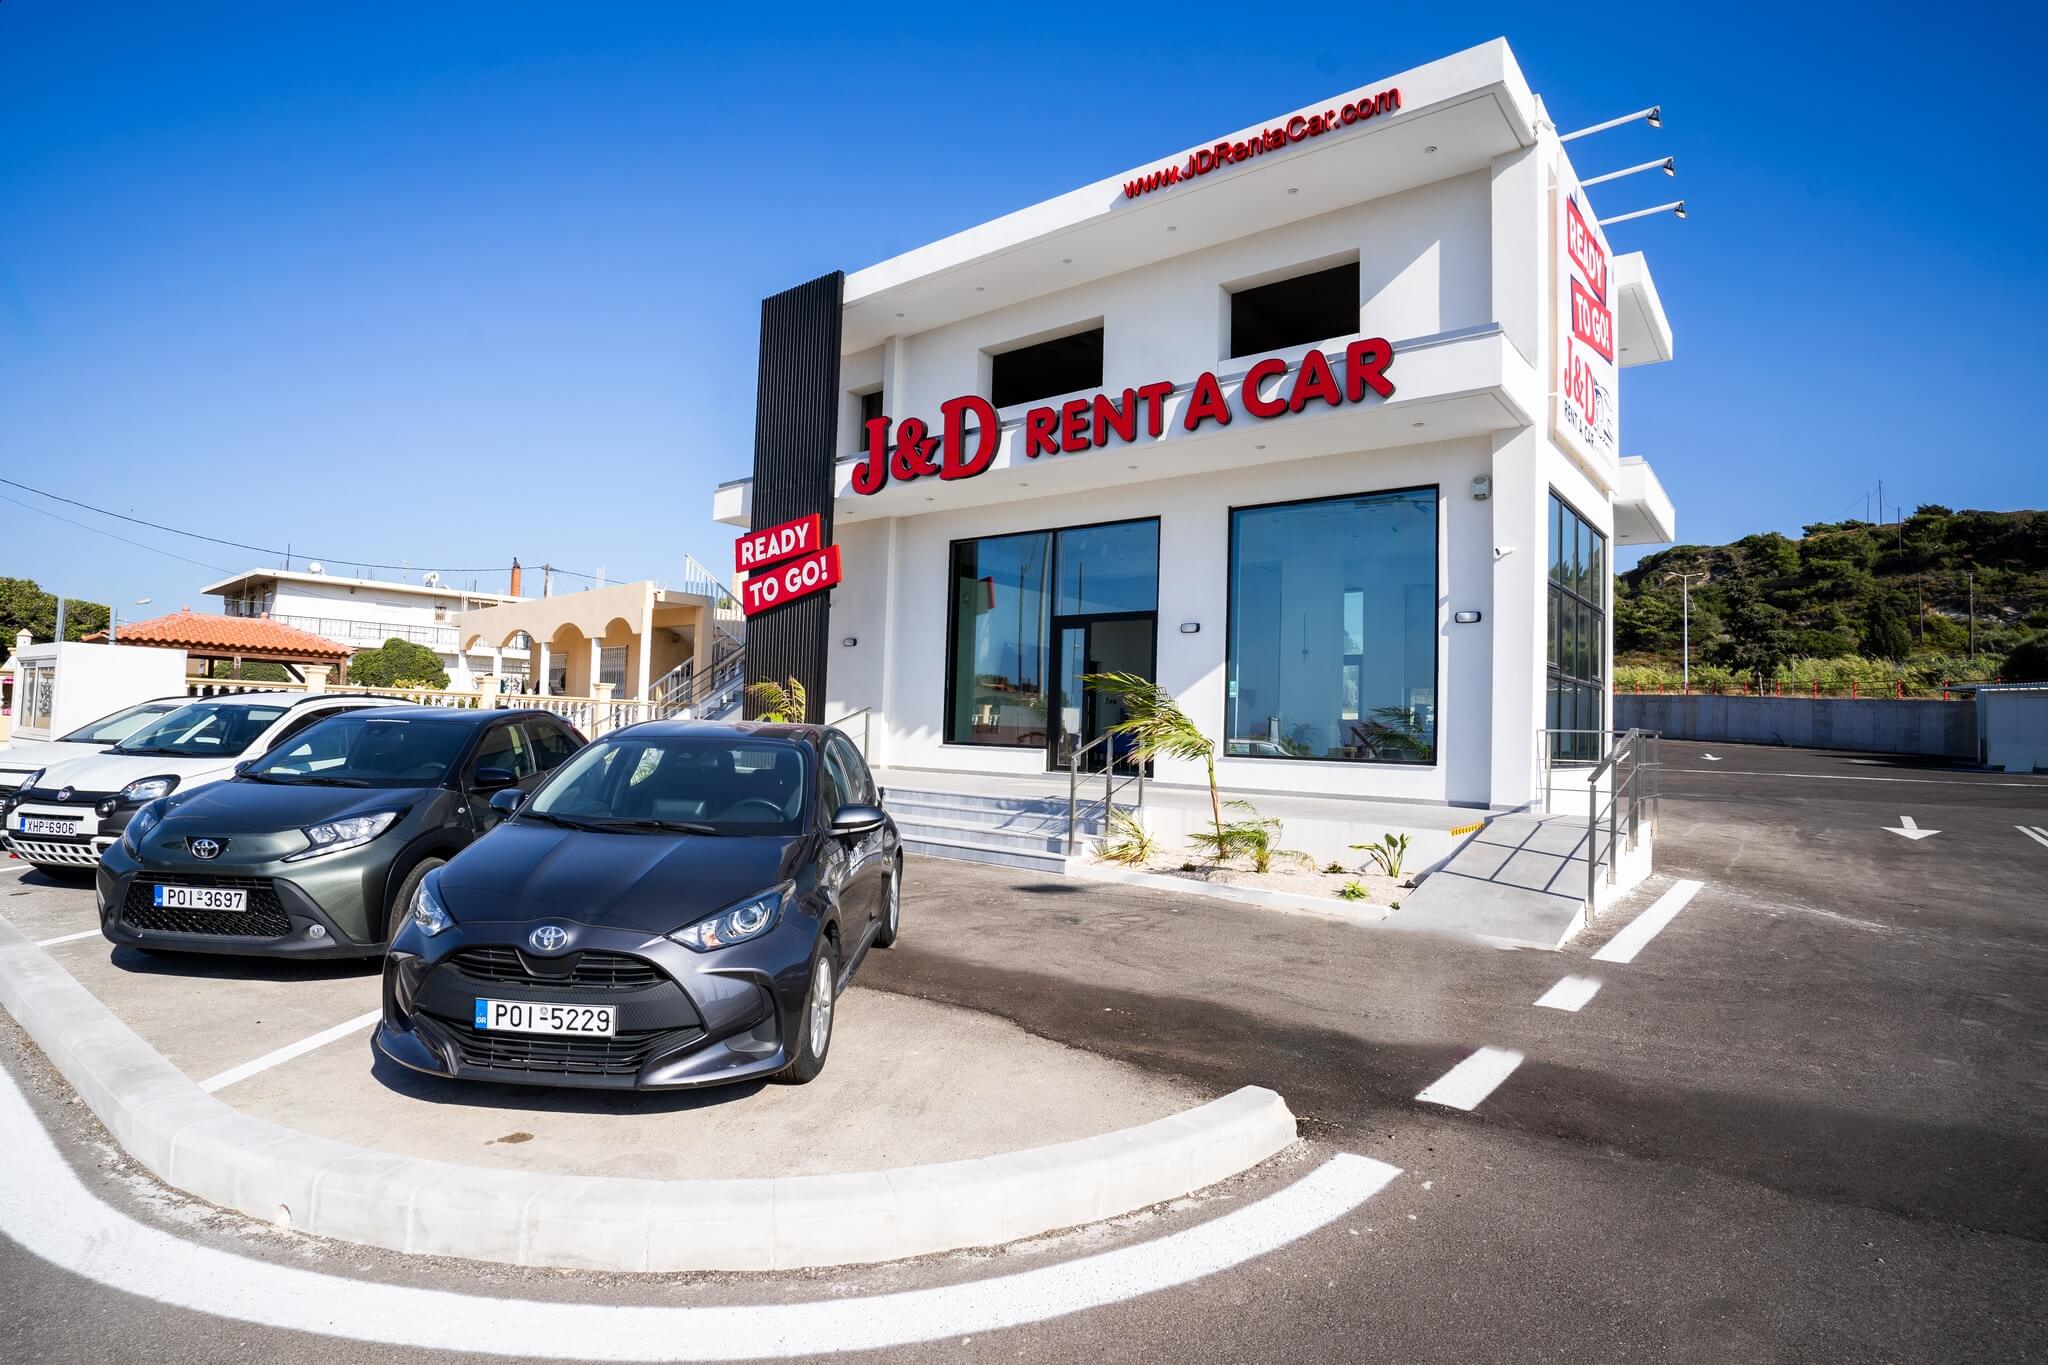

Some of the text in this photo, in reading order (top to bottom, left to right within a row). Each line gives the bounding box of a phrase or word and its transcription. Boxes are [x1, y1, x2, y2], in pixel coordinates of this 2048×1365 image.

[1123, 87, 1401, 199] www.JDRentaCar.com
[1569, 211, 1602, 289] READY
[1576, 292, 1610, 352] TO GO!
[1563, 335, 1595, 427] J&D
[1564, 399, 1578, 431] RENT
[850, 337, 1396, 496] J&D RENT A CAR
[741, 522, 809, 566] READY
[749, 555, 828, 607] TO GO!
